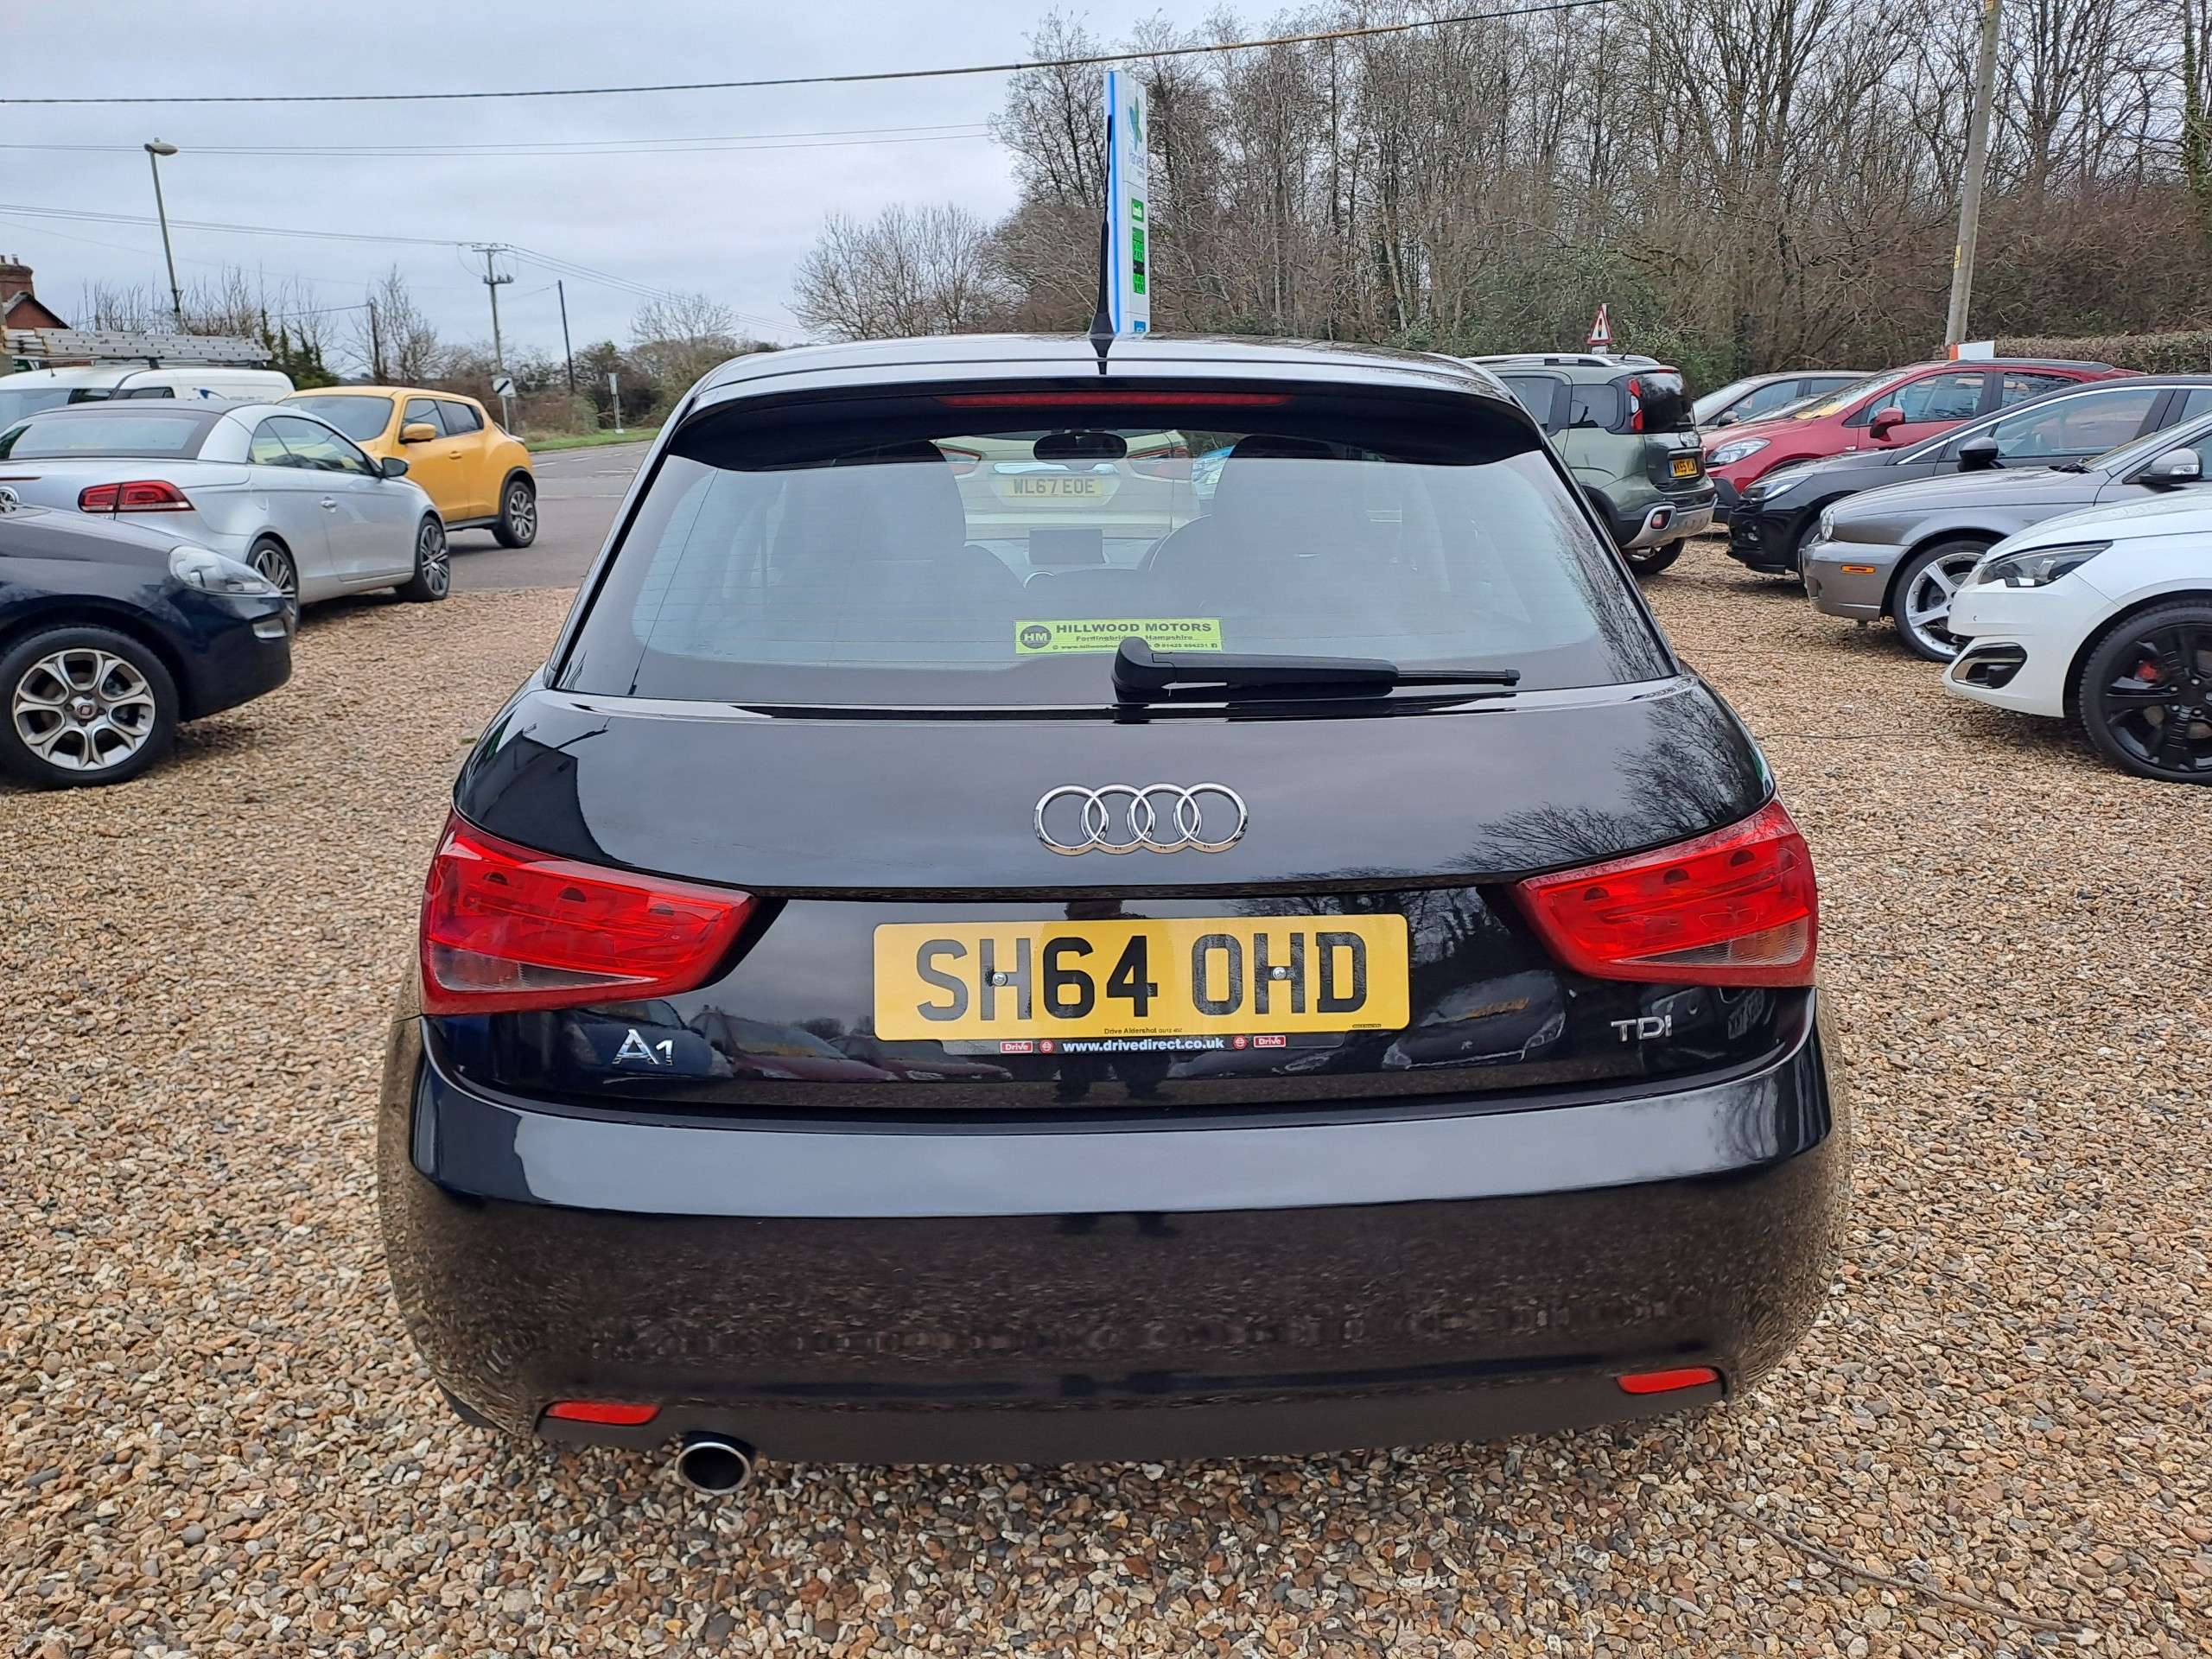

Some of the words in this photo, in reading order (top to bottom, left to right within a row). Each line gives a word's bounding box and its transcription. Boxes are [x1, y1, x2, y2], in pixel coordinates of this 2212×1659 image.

[1014, 478, 1058, 494] WL67
[1063, 478, 1096, 493] EOE
[1056, 623, 1140, 632] HILLWOOD
[1145, 623, 1211, 632] MOTORS
[1023, 632, 1048, 642] HM
[916, 935, 1159, 1022] SH64
[1191, 931, 1369, 1017] OHD
[1611, 1014, 1673, 1042] TDI
[612, 1028, 674, 1066] A1
[1005, 1042, 1029, 1051] Drive
[1063, 1039, 1224, 1052] www.drivedirect.co.uk
[1258, 1036, 1282, 1046] Drive
